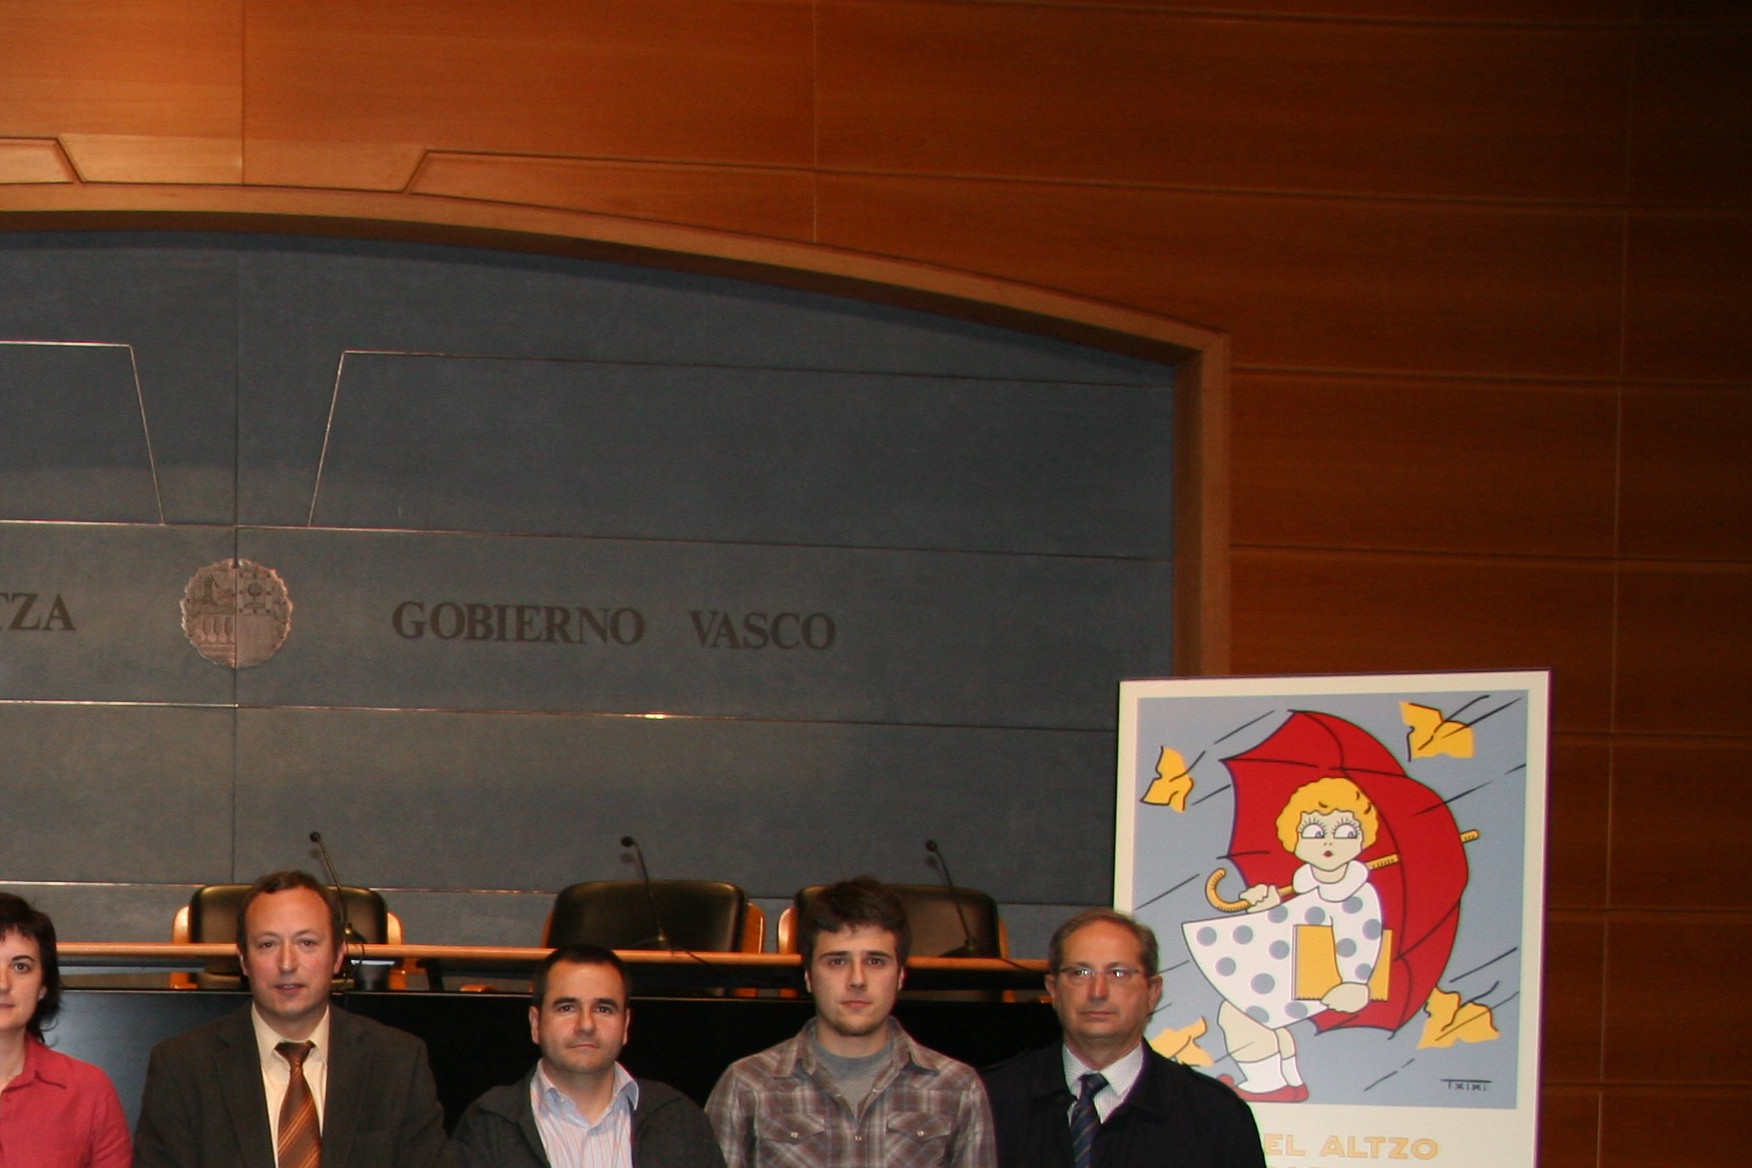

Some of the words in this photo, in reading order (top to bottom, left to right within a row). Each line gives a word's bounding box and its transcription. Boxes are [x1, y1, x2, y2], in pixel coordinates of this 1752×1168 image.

[392, 601, 645, 646] GOBIERNO
[688, 609, 837, 650] VASCO
[1262, 1133, 1306, 1157] EL
[1319, 1134, 1439, 1161] ALTZO
